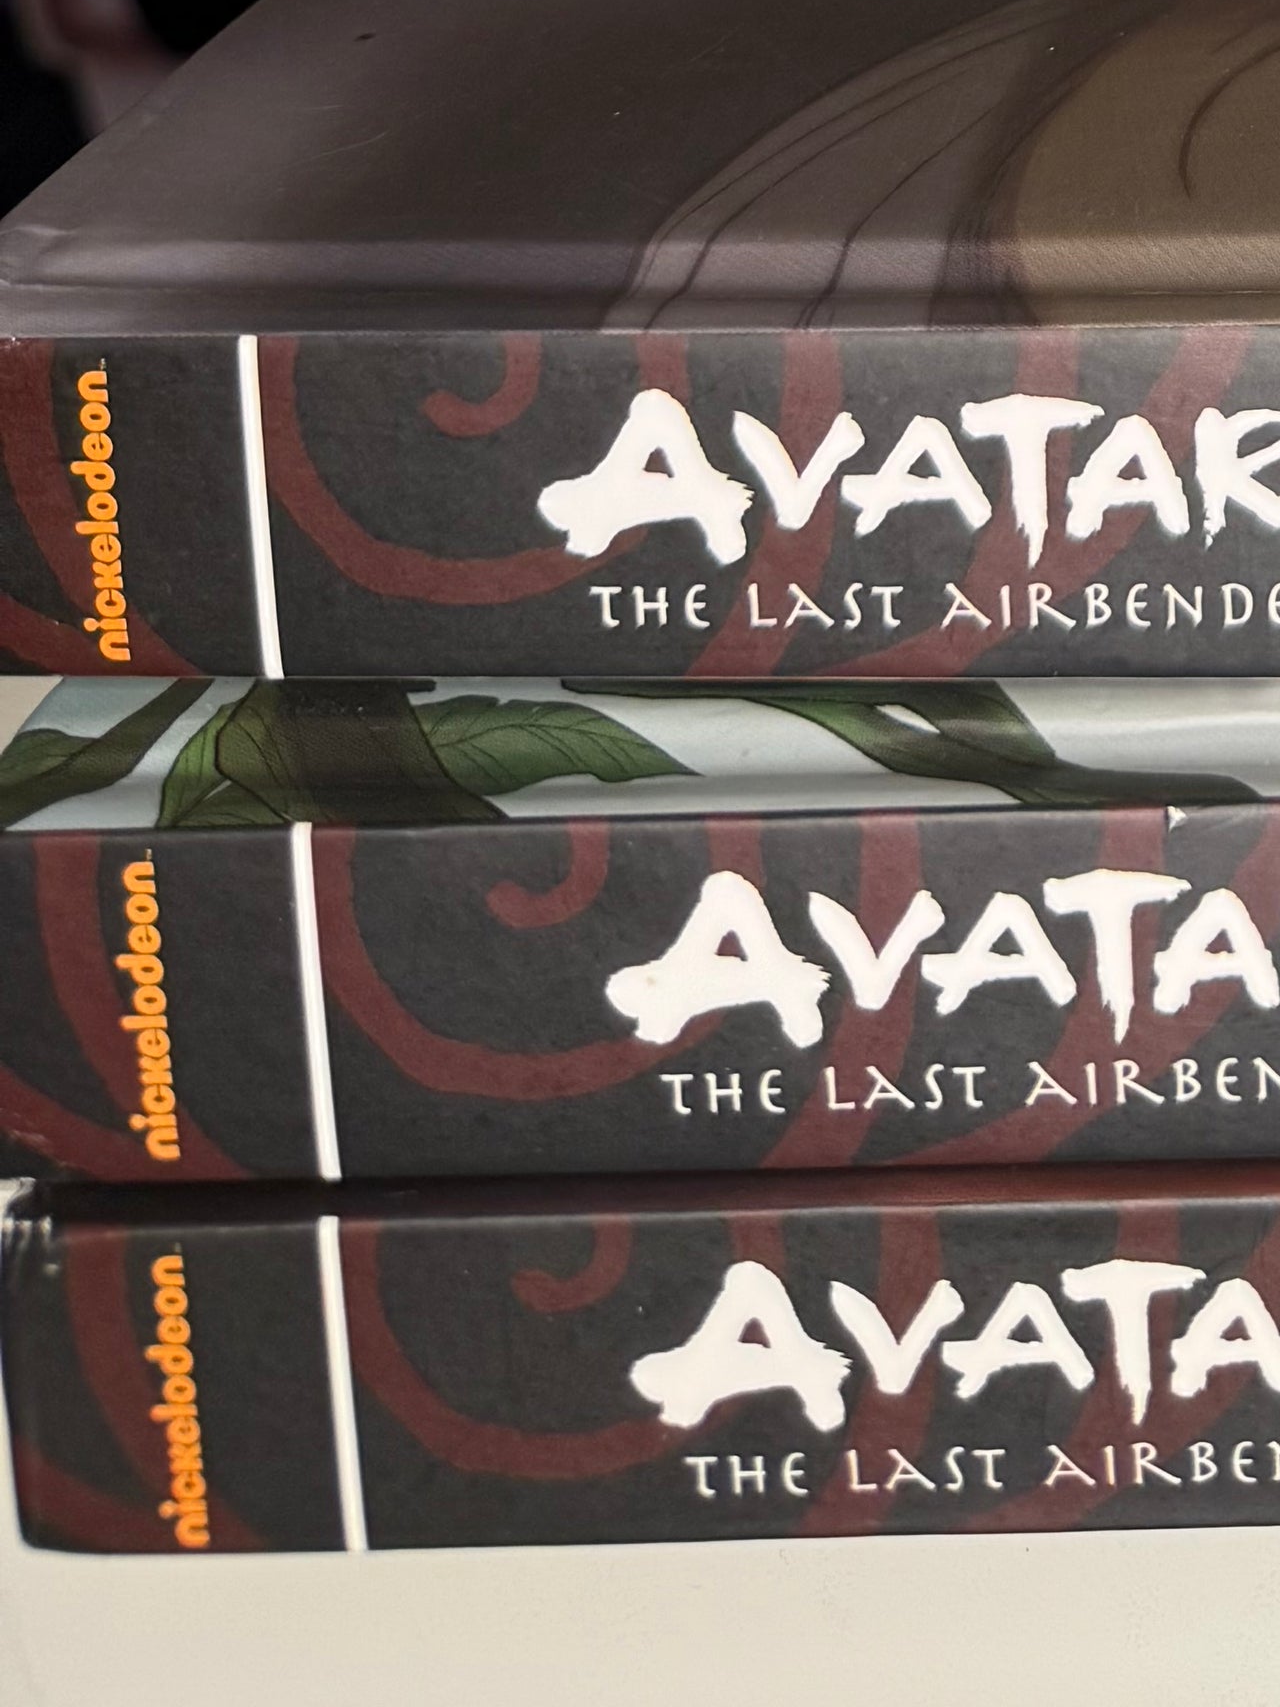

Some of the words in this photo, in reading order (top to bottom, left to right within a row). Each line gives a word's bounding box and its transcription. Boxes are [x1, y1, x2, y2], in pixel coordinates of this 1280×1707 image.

[588, 582, 711, 629] THE
[746, 581, 904, 631] LAST
[658, 1068, 787, 1116] THE
[823, 1062, 987, 1112] LAST
[684, 1451, 810, 1498] THE
[845, 1445, 1007, 1492] LAST
